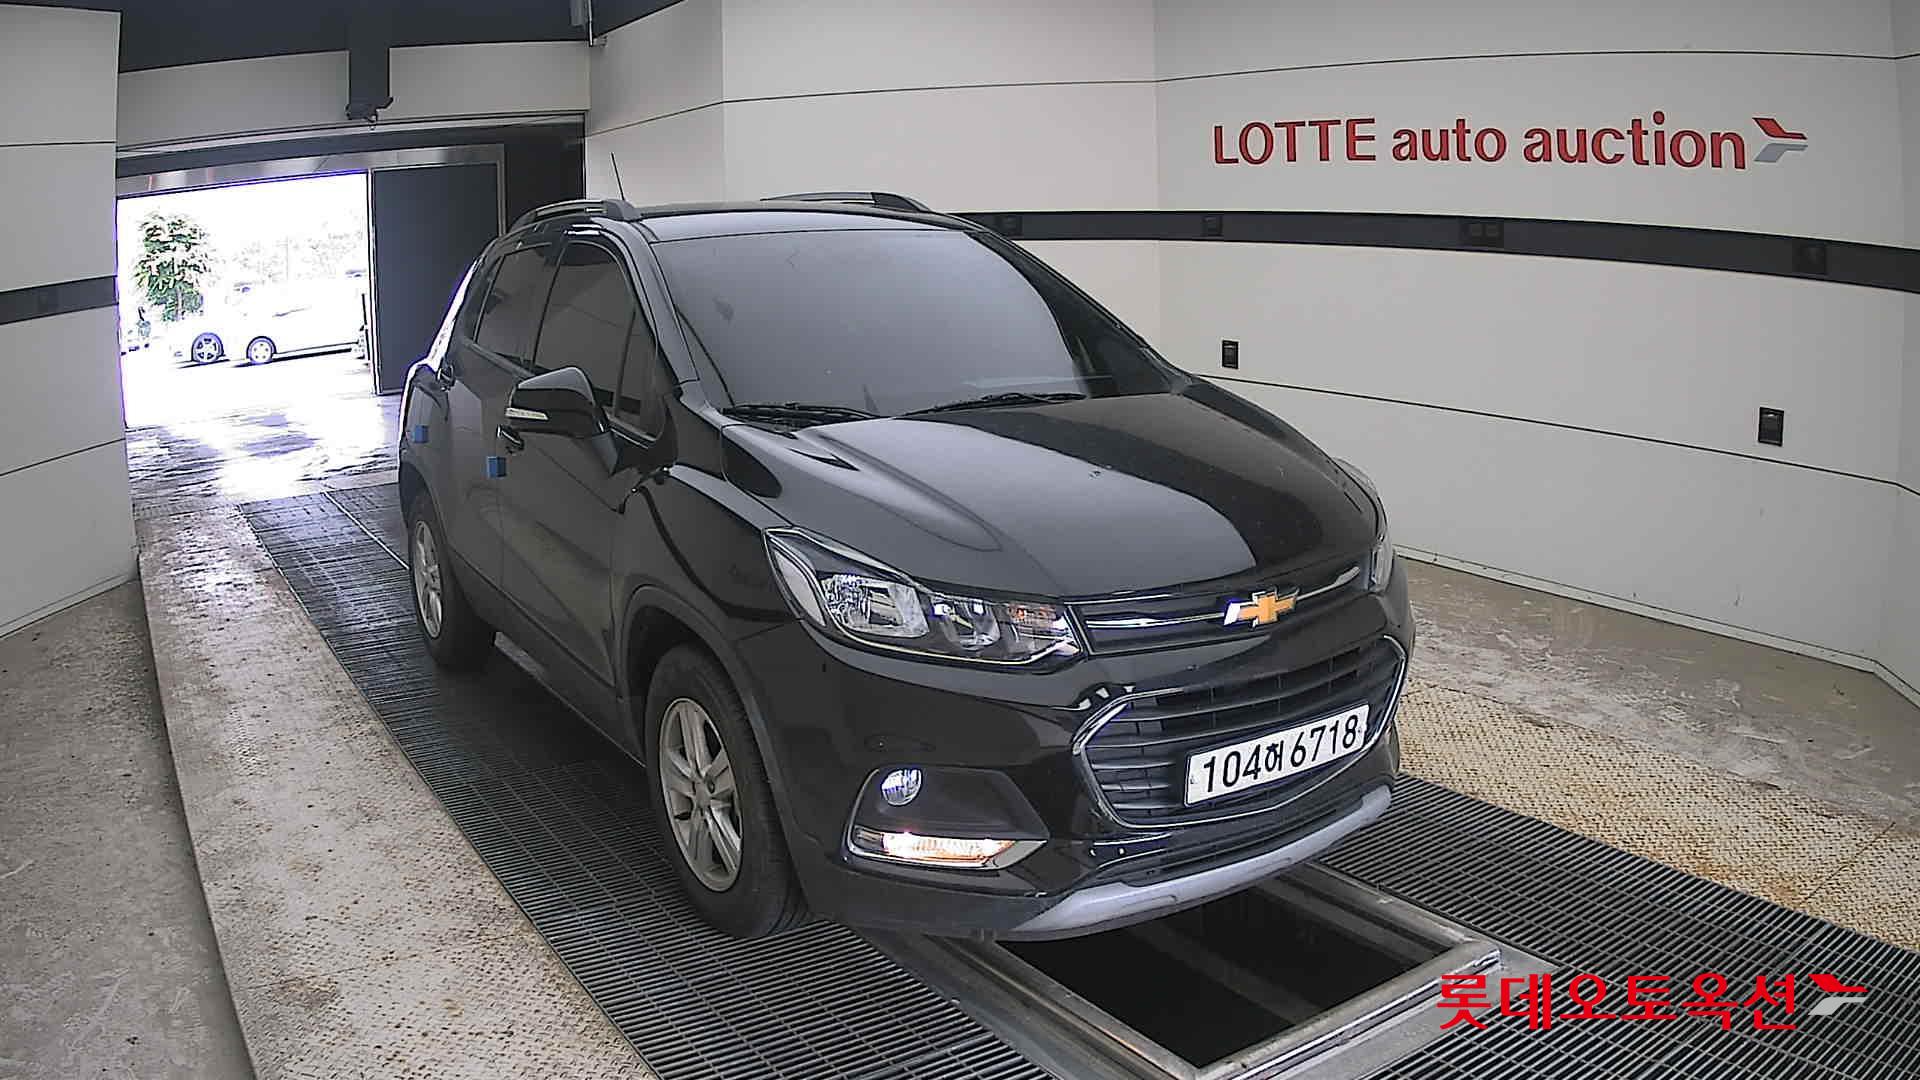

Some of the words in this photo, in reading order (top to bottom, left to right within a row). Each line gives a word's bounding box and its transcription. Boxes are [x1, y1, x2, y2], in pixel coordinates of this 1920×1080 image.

[1213, 118, 1376, 164] LOTTE
[1392, 118, 1507, 163] auto
[1523, 111, 1746, 170] auction
